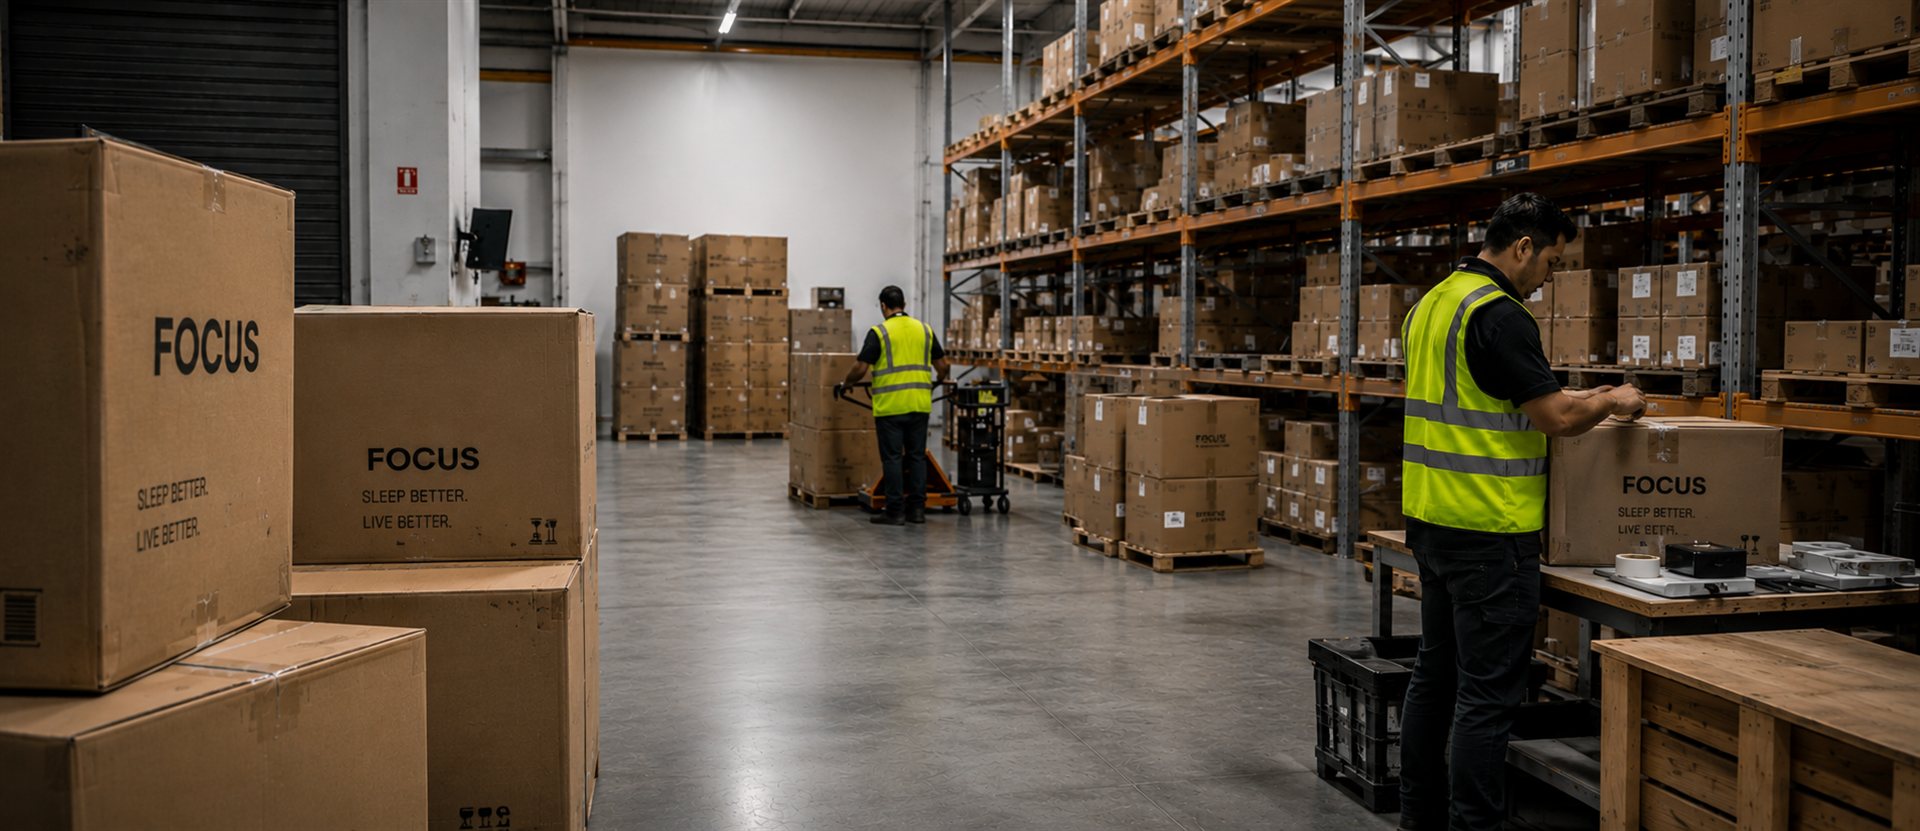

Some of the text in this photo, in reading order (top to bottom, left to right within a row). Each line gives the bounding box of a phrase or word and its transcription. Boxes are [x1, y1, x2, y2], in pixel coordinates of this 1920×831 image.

[154, 316, 259, 376] FOCUS
[367, 447, 480, 471] FOCUS
[137, 476, 209, 511] SLEEP BETTER.
[1623, 476, 1706, 495] FOCUS
[362, 489, 468, 503] SLEEP BETTER.
[363, 514, 452, 529] LIVE BETTER.
[1618, 507, 1696, 518] SLEEP BETTER.
[136, 516, 201, 552] LIVE BETTER.
[1618, 524, 1640, 535] LIVE
